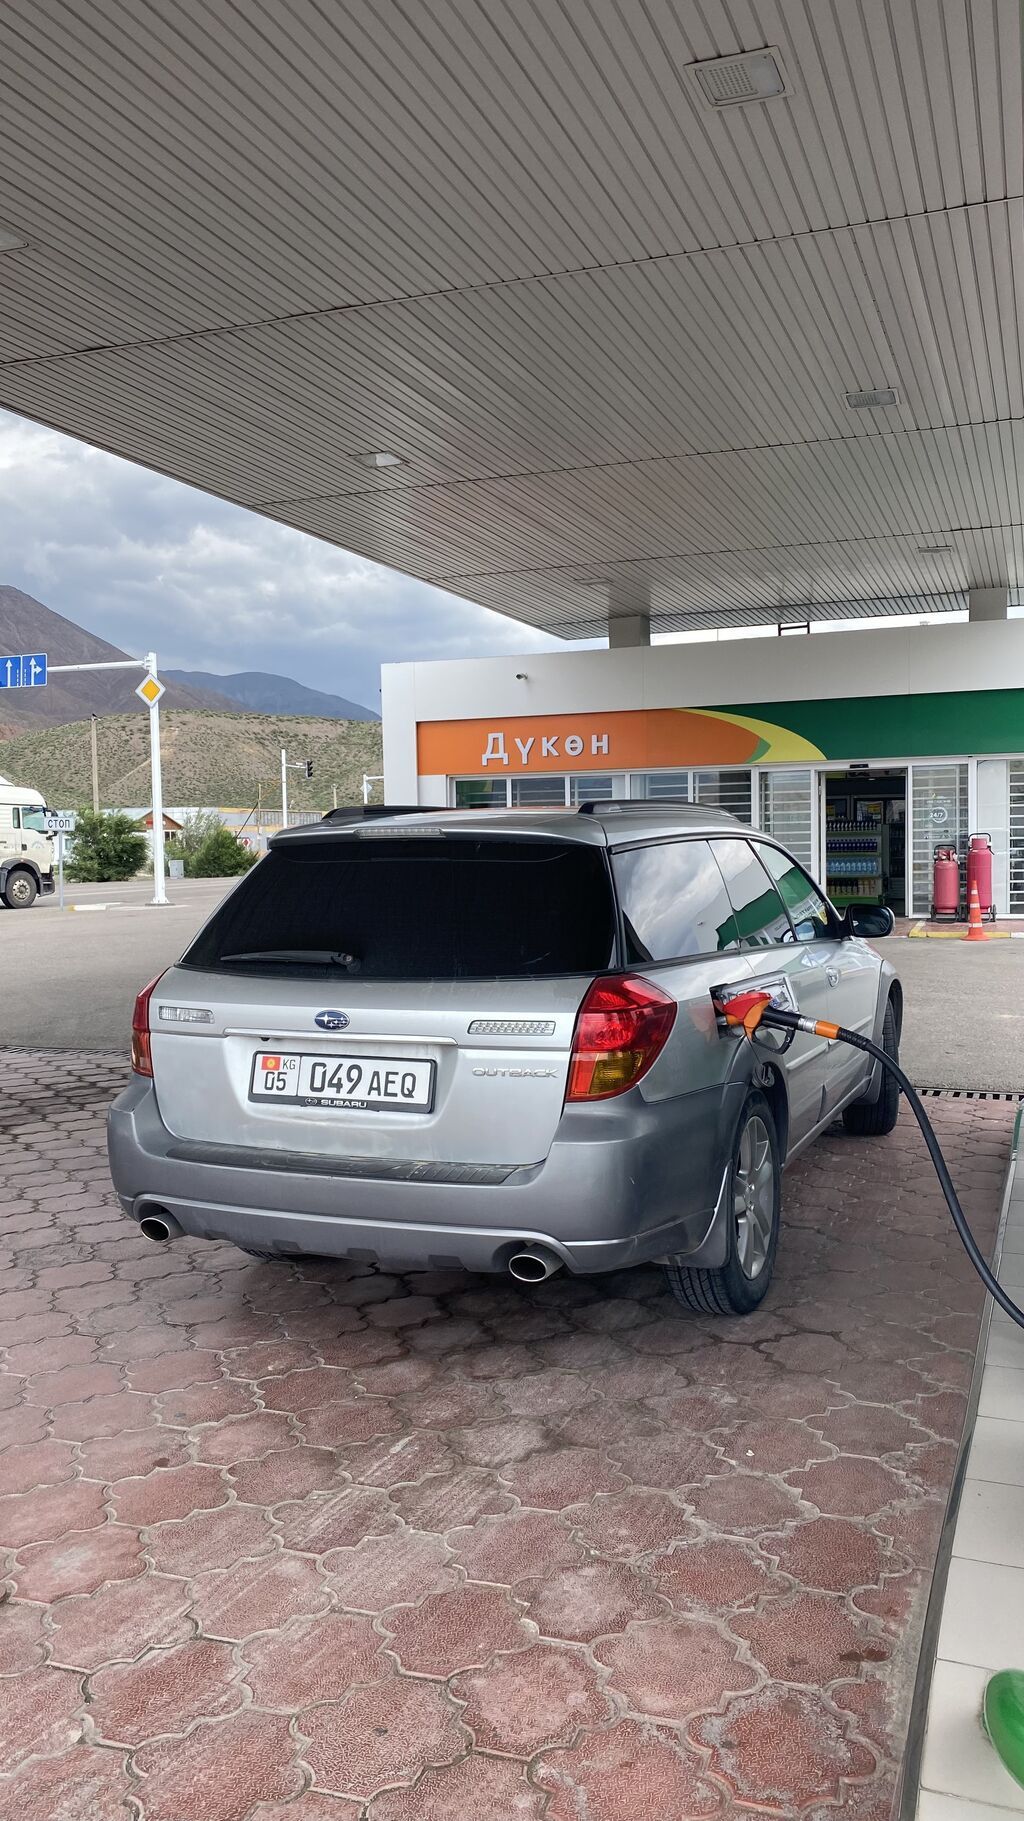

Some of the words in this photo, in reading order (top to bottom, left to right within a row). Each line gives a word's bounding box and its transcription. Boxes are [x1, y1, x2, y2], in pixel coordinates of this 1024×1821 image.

[481, 732, 609, 766] Дүкөн
[47, 819, 71, 829] СТОП
[282, 1059, 296, 1070] KG
[472, 1067, 559, 1079] OUTBACK
[264, 1071, 288, 1091] 05
[309, 1062, 363, 1095] 049
[367, 1070, 417, 1099] AEQ
[320, 1099, 367, 1109] SUBARU
